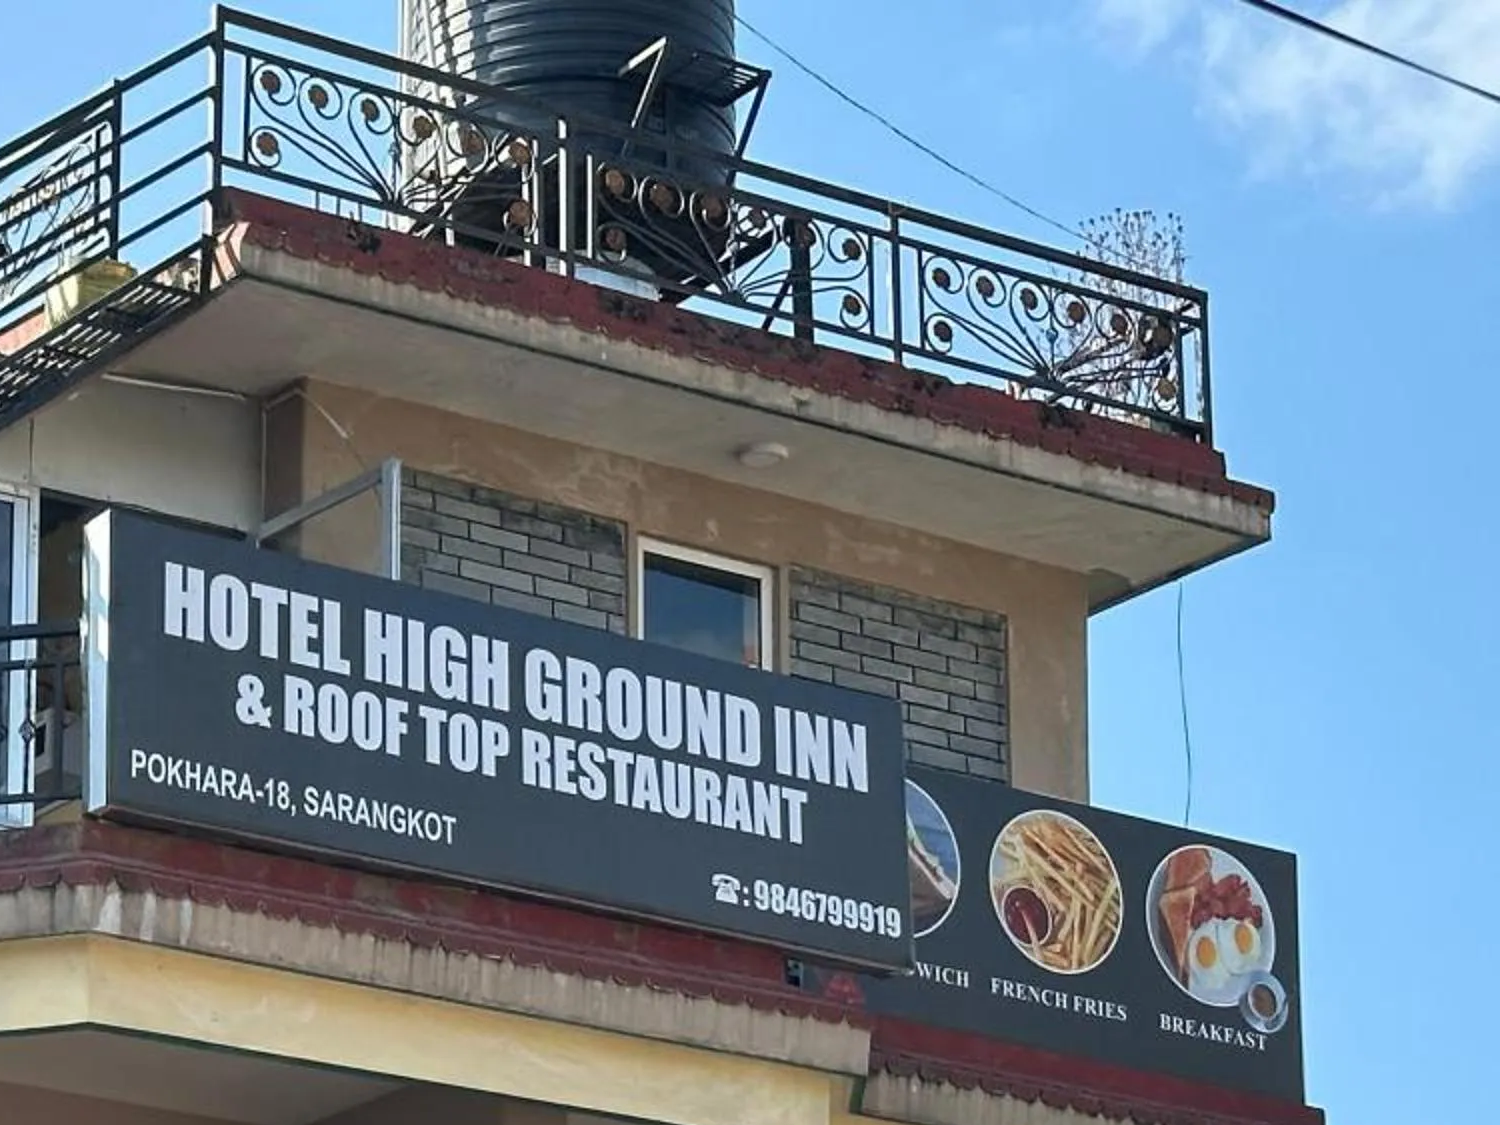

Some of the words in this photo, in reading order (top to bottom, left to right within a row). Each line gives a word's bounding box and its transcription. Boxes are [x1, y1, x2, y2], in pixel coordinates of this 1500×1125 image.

[163, 562, 350, 674] HOTEL
[364, 609, 510, 711] HIGH
[524, 649, 760, 768] GROUND
[773, 706, 869, 793] INN
[131, 750, 296, 817] POKHARA-18,
[304, 786, 457, 845] SARANGKOT
[235, 673, 272, 727] &
[284, 676, 409, 755] ROOF
[419, 706, 510, 777] TOP
[522, 728, 808, 844] RESTAURANT
[991, 978, 1068, 1009] FRENCH
[1073, 996, 1128, 1021] FRIES
[1160, 1013, 1268, 1051] BREAKFAST
